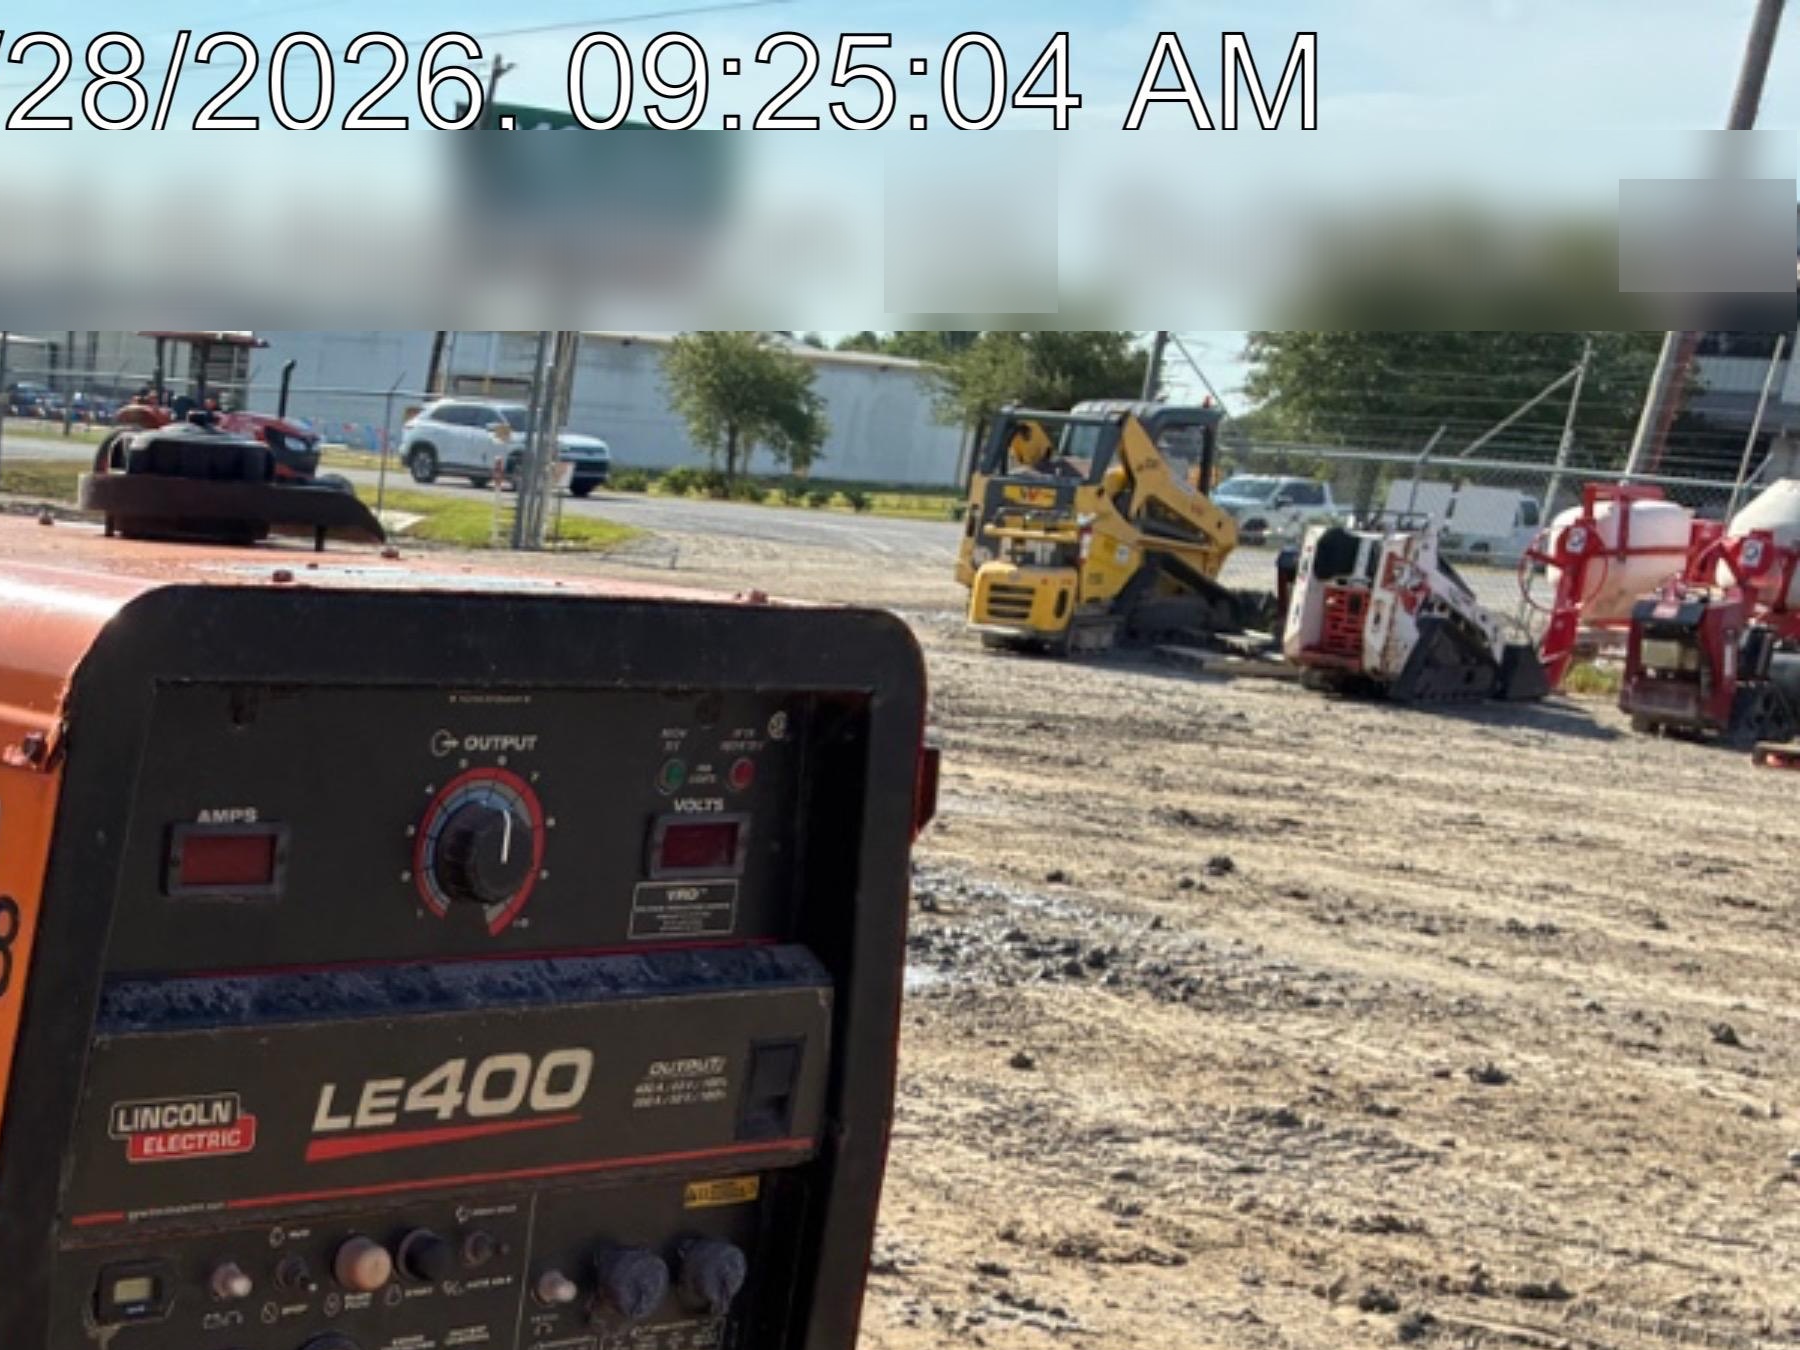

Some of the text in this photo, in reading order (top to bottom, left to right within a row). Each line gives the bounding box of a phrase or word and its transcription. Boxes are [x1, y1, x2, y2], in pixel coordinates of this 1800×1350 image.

[464, 735, 538, 751] OUTPUT
[197, 806, 259, 824] AMPS
[673, 798, 725, 813] VOLTS
[311, 1047, 595, 1132] LE400
[116, 1099, 233, 1133] LINCOLN
[142, 1128, 242, 1156] ELECTRIC
